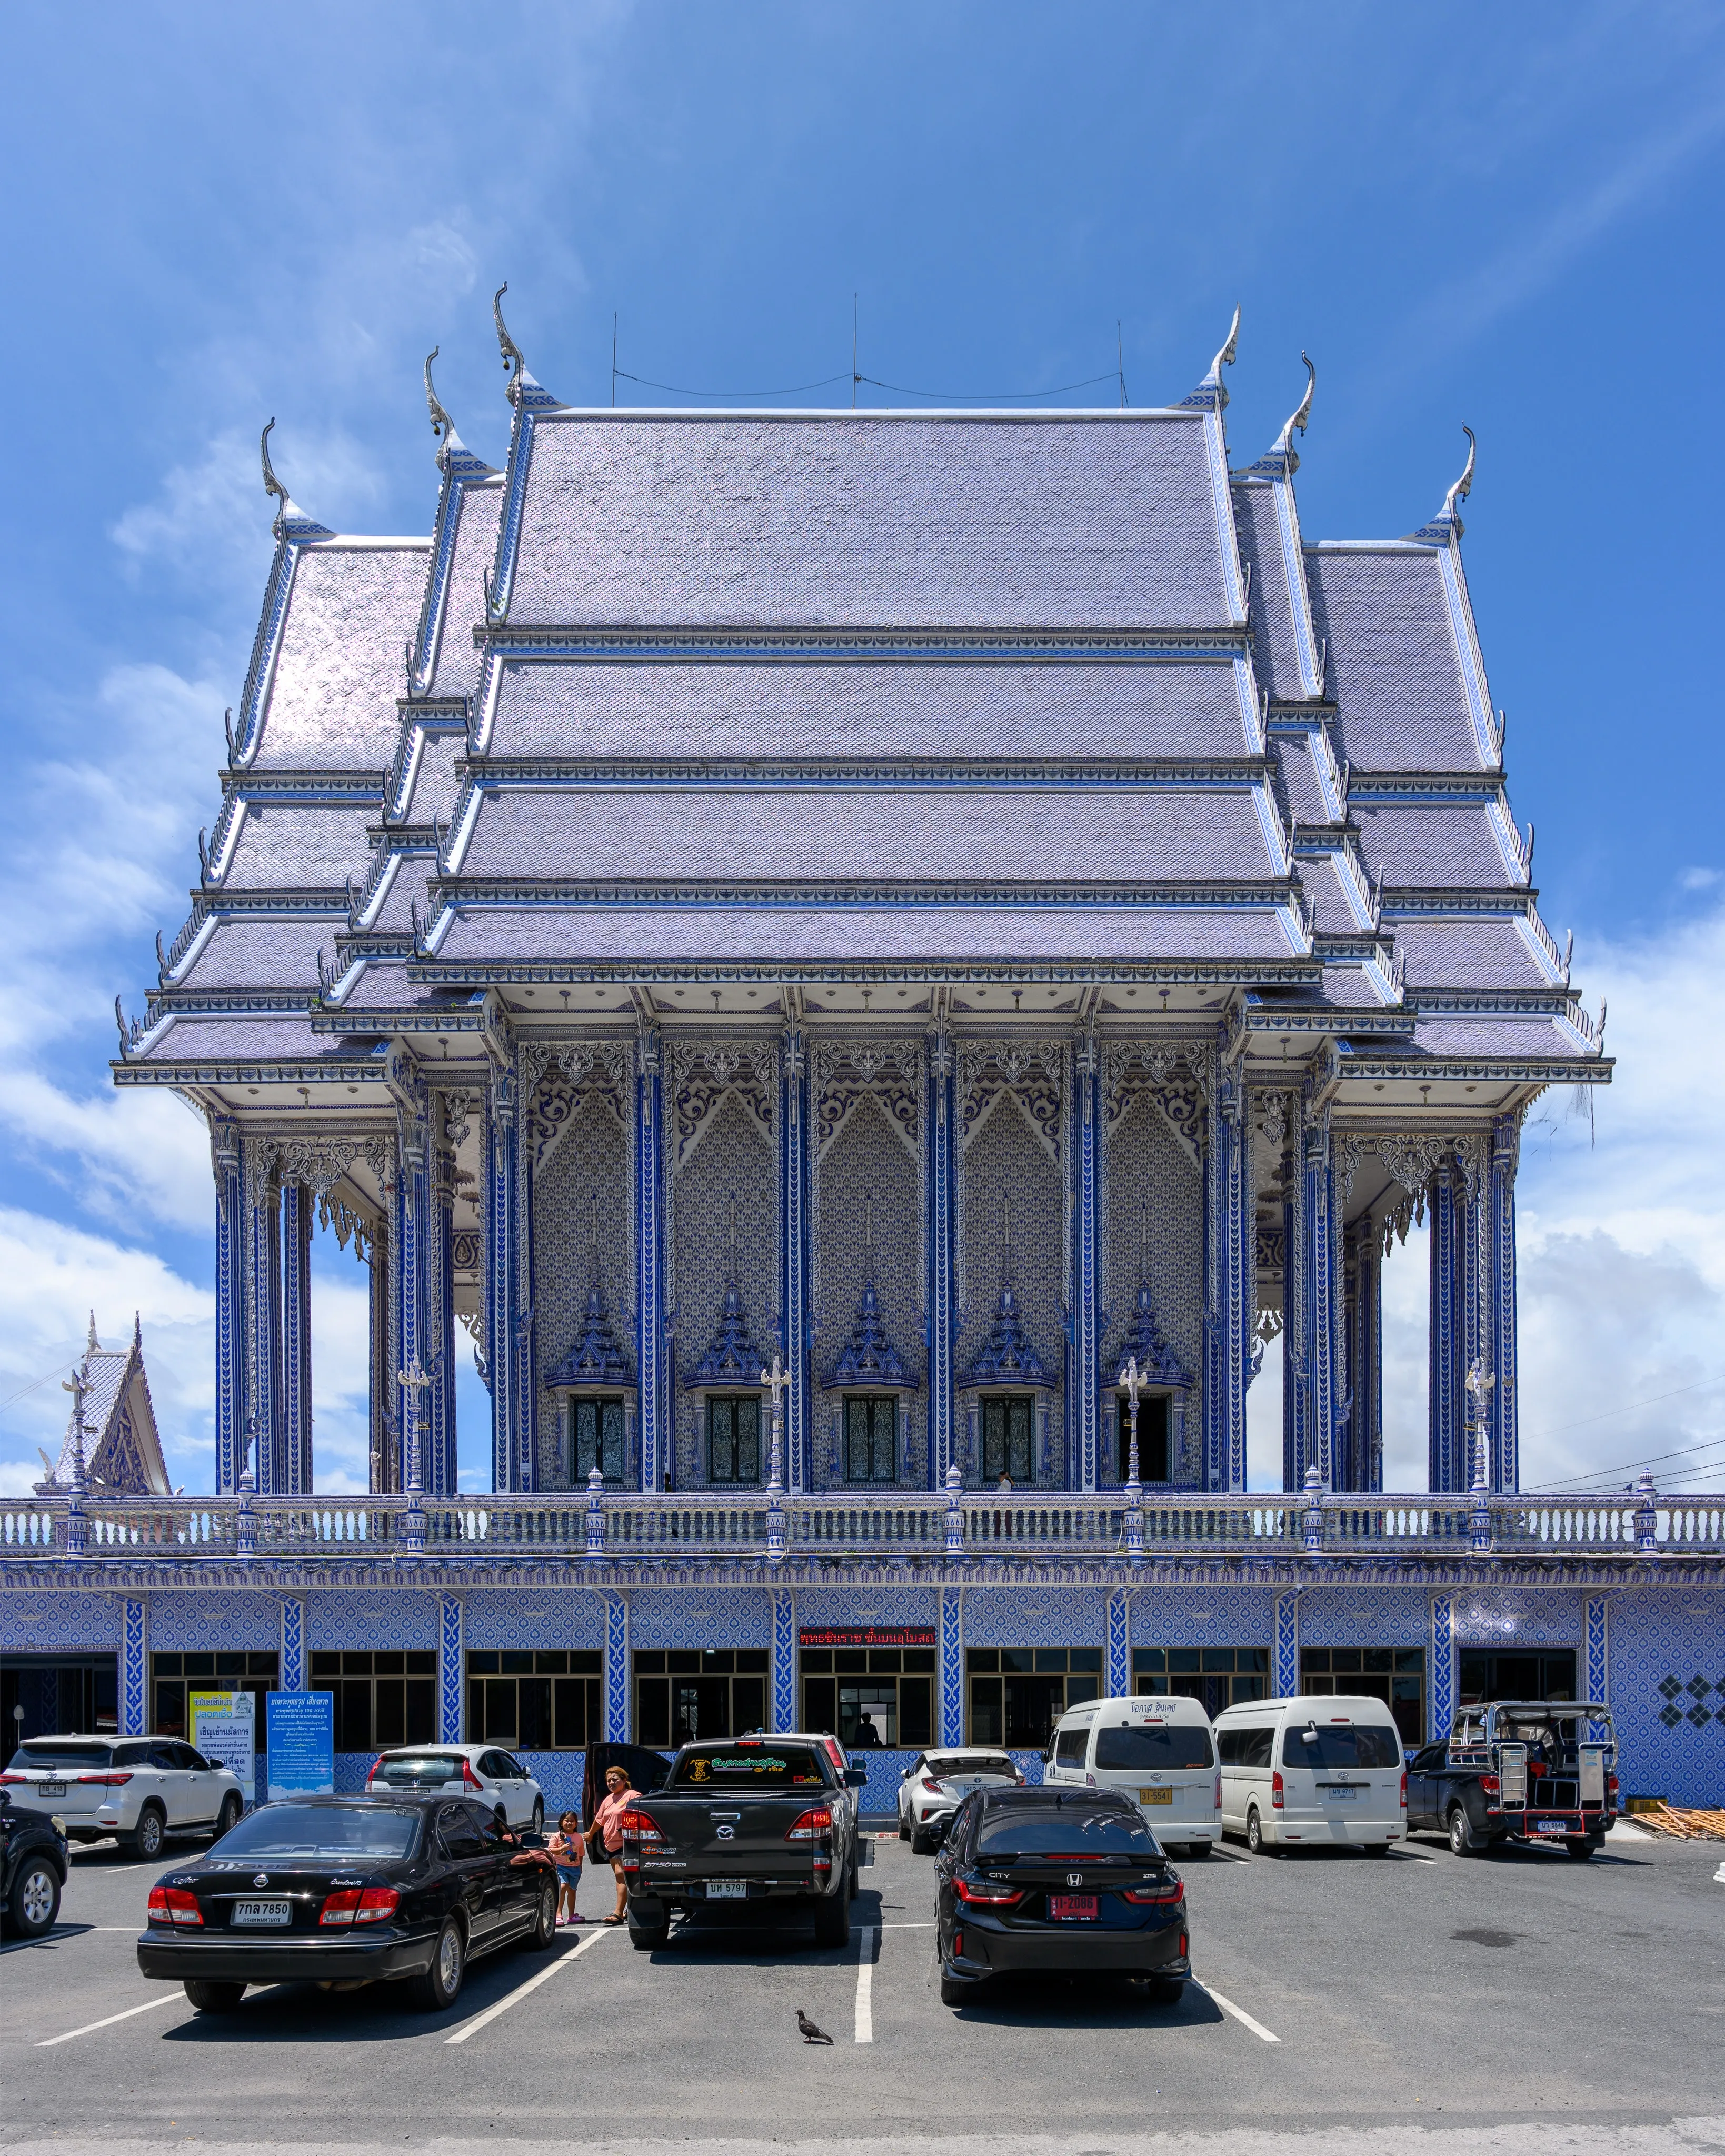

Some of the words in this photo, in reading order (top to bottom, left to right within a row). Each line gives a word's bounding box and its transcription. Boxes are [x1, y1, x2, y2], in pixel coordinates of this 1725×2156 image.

[271, 1698, 305, 1708] ยกพระพุทธรูป
[306, 1694, 329, 1705] เสี่ยงทาย
[195, 1708, 232, 1718] ปลอดเชื้อ
[200, 1725, 249, 1738] เชิญเข้านมัสการ
[239, 1904, 260, 1914] 7กล
[263, 1904, 288, 1914] 7850
